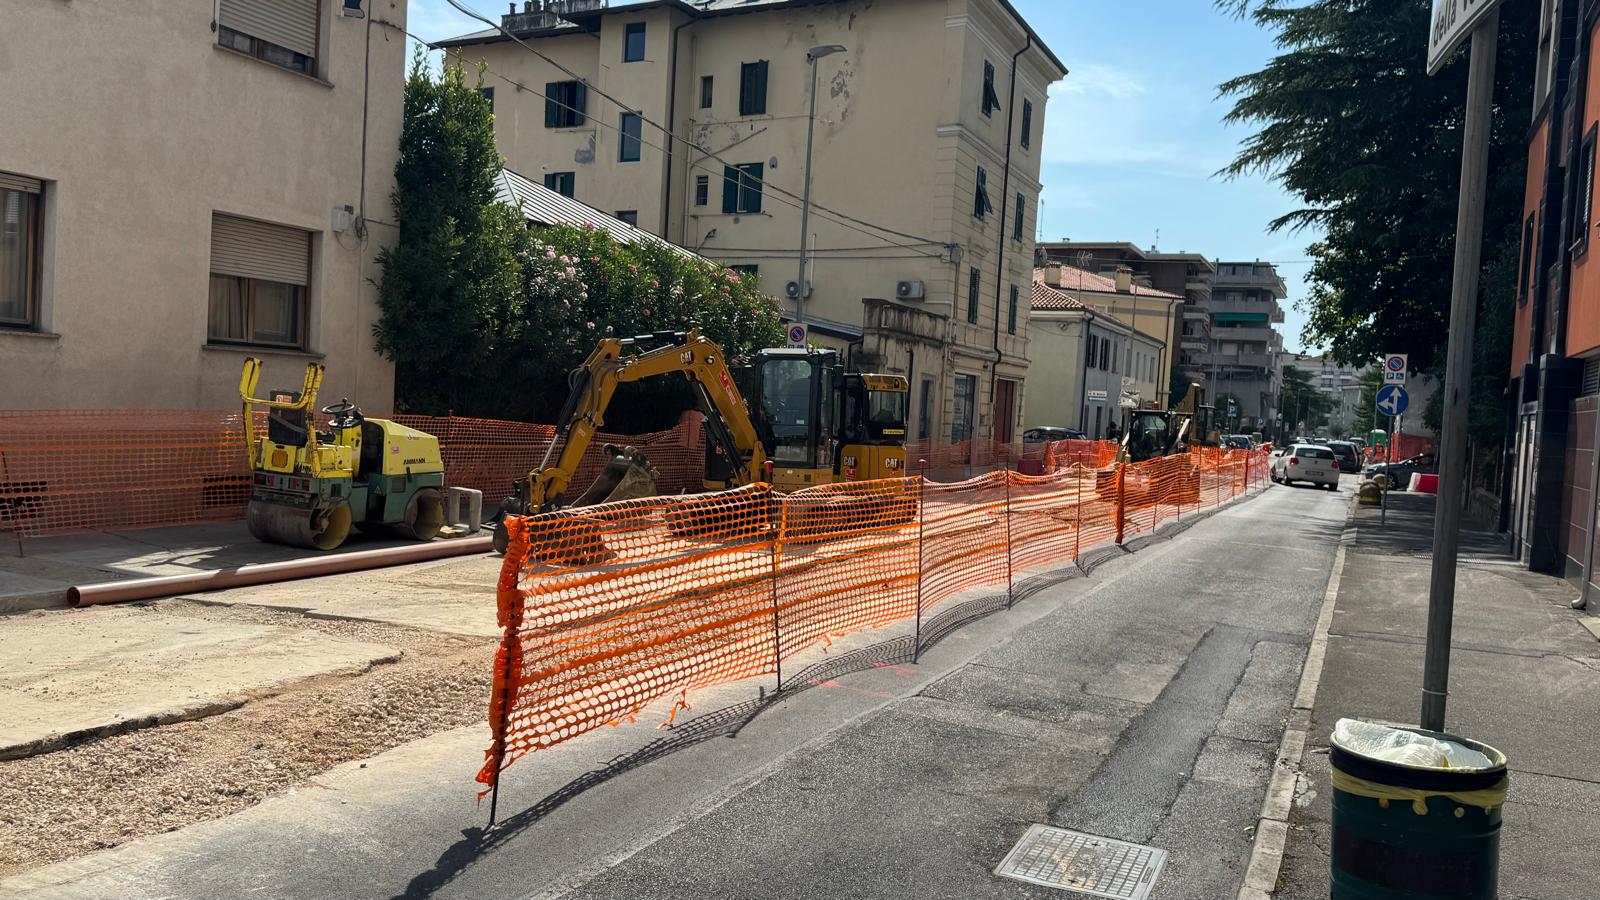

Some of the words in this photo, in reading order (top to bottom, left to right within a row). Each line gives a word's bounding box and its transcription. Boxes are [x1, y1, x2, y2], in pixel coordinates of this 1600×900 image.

[1433, 0, 1457, 48] della
[680, 351, 692, 364] CAT
[843, 456, 855, 466] CAT
[885, 458, 897, 468] CAT
